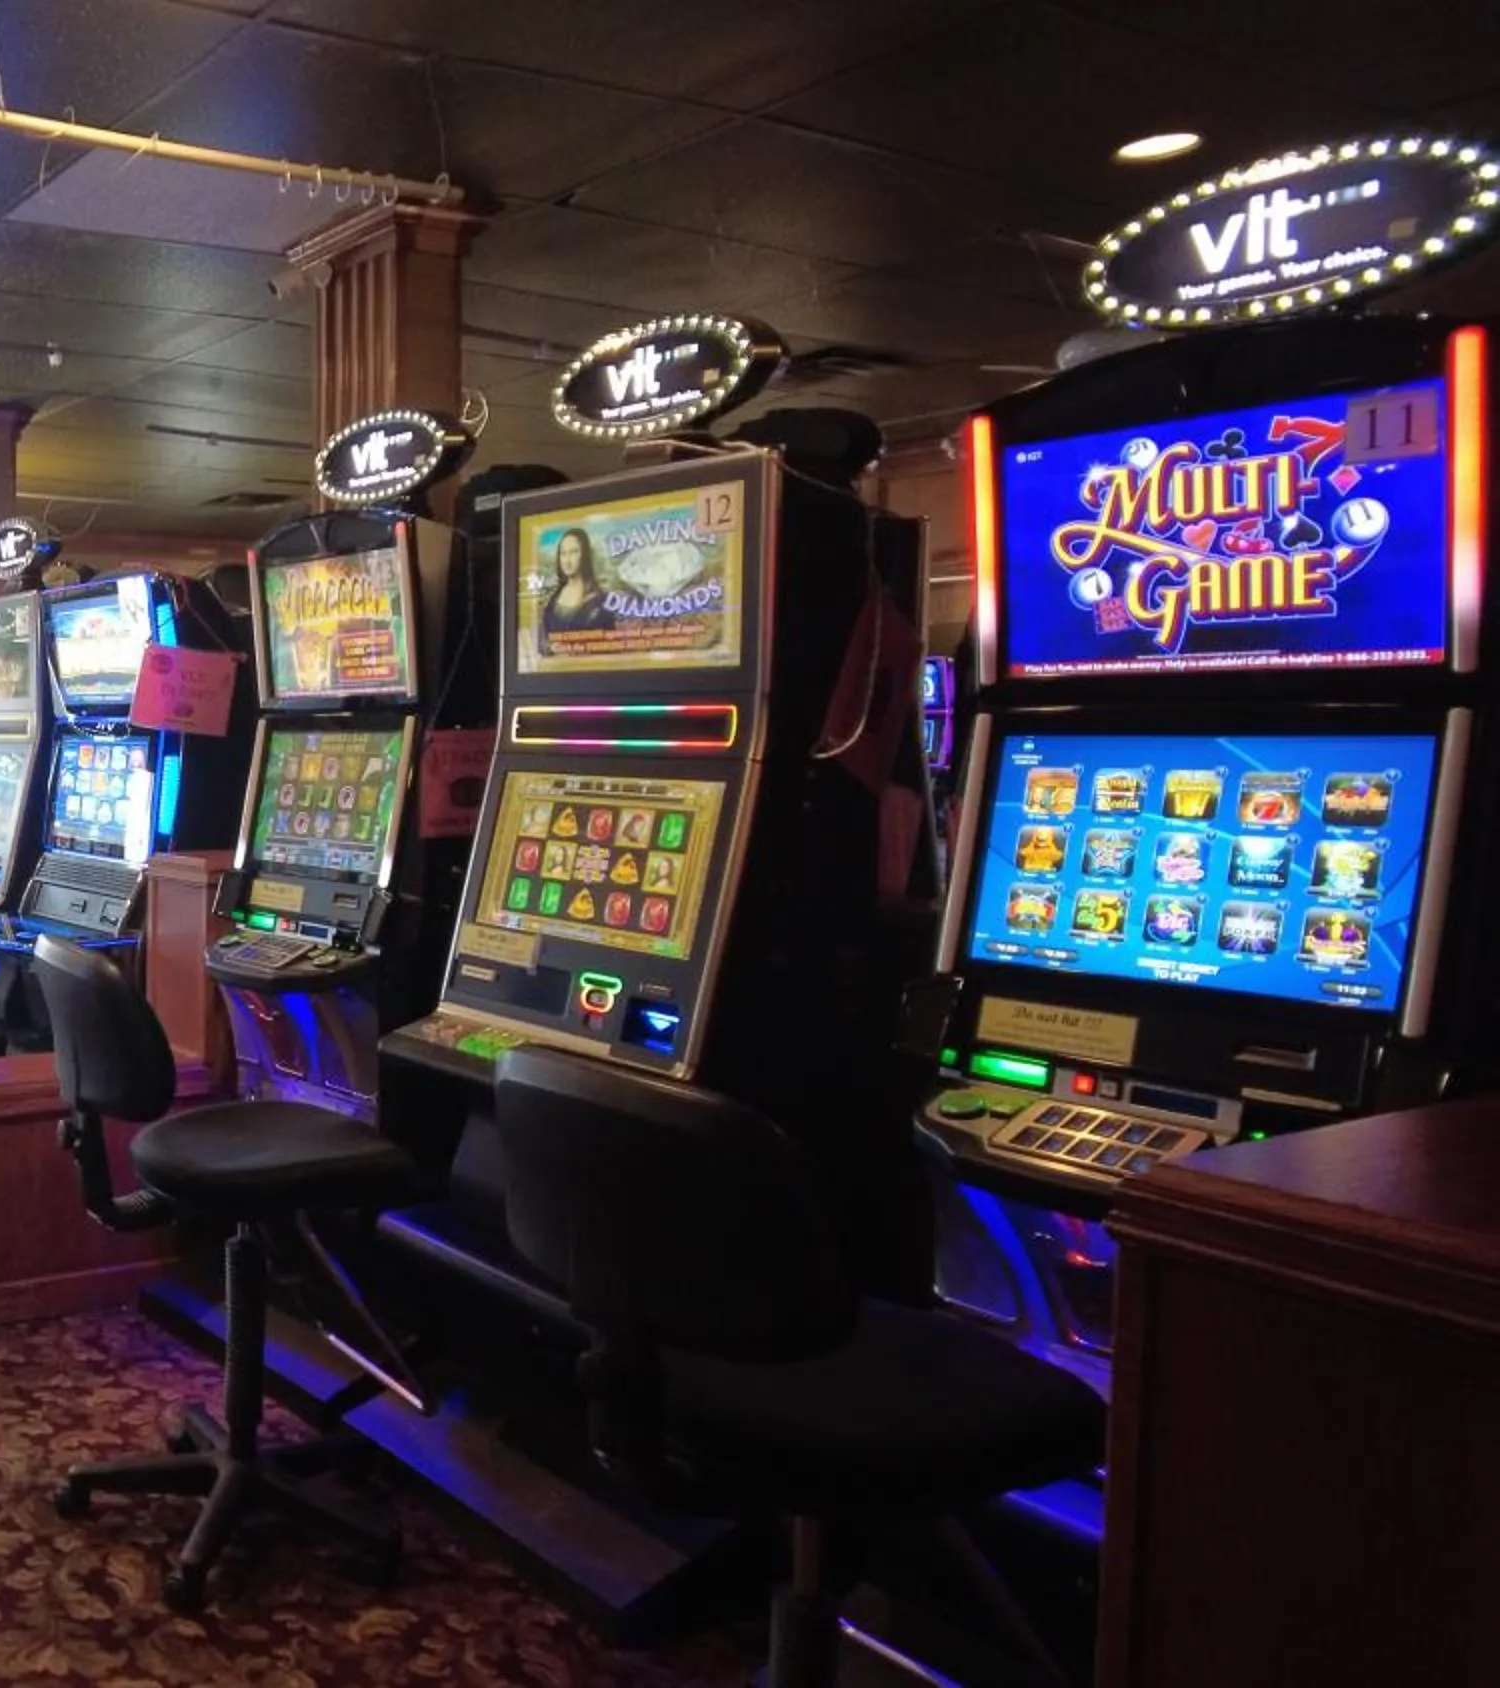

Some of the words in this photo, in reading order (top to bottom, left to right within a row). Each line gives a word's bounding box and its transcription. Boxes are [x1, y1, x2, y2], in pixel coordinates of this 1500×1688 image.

[1190, 189, 1299, 273] vlt
[607, 345, 662, 402] vlt
[704, 494, 732, 527] 12
[604, 578, 722, 618] DIAMONDS
[1127, 548, 1336, 652] GAME
